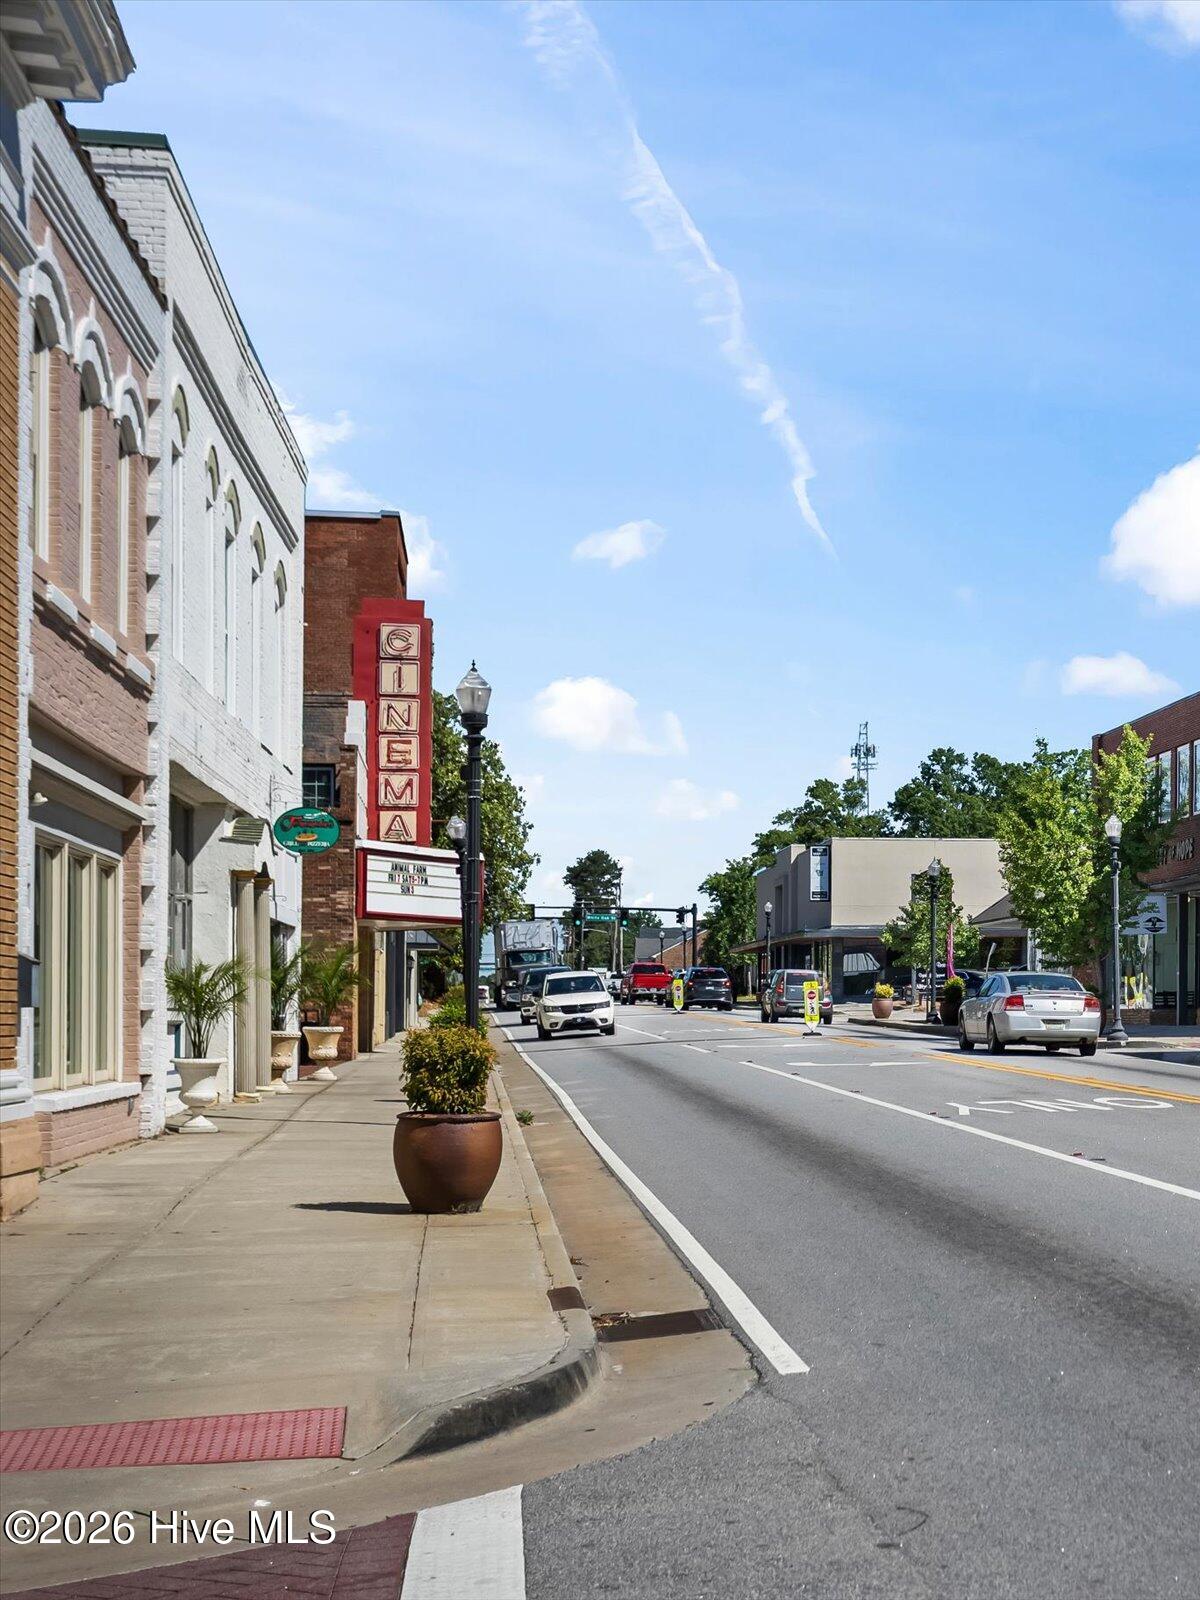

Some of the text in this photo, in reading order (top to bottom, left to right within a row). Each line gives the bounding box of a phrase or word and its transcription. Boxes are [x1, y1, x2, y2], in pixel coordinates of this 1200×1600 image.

[383, 628, 414, 840] CINEMA
[390, 863, 427, 875] ANIMAL FARM
